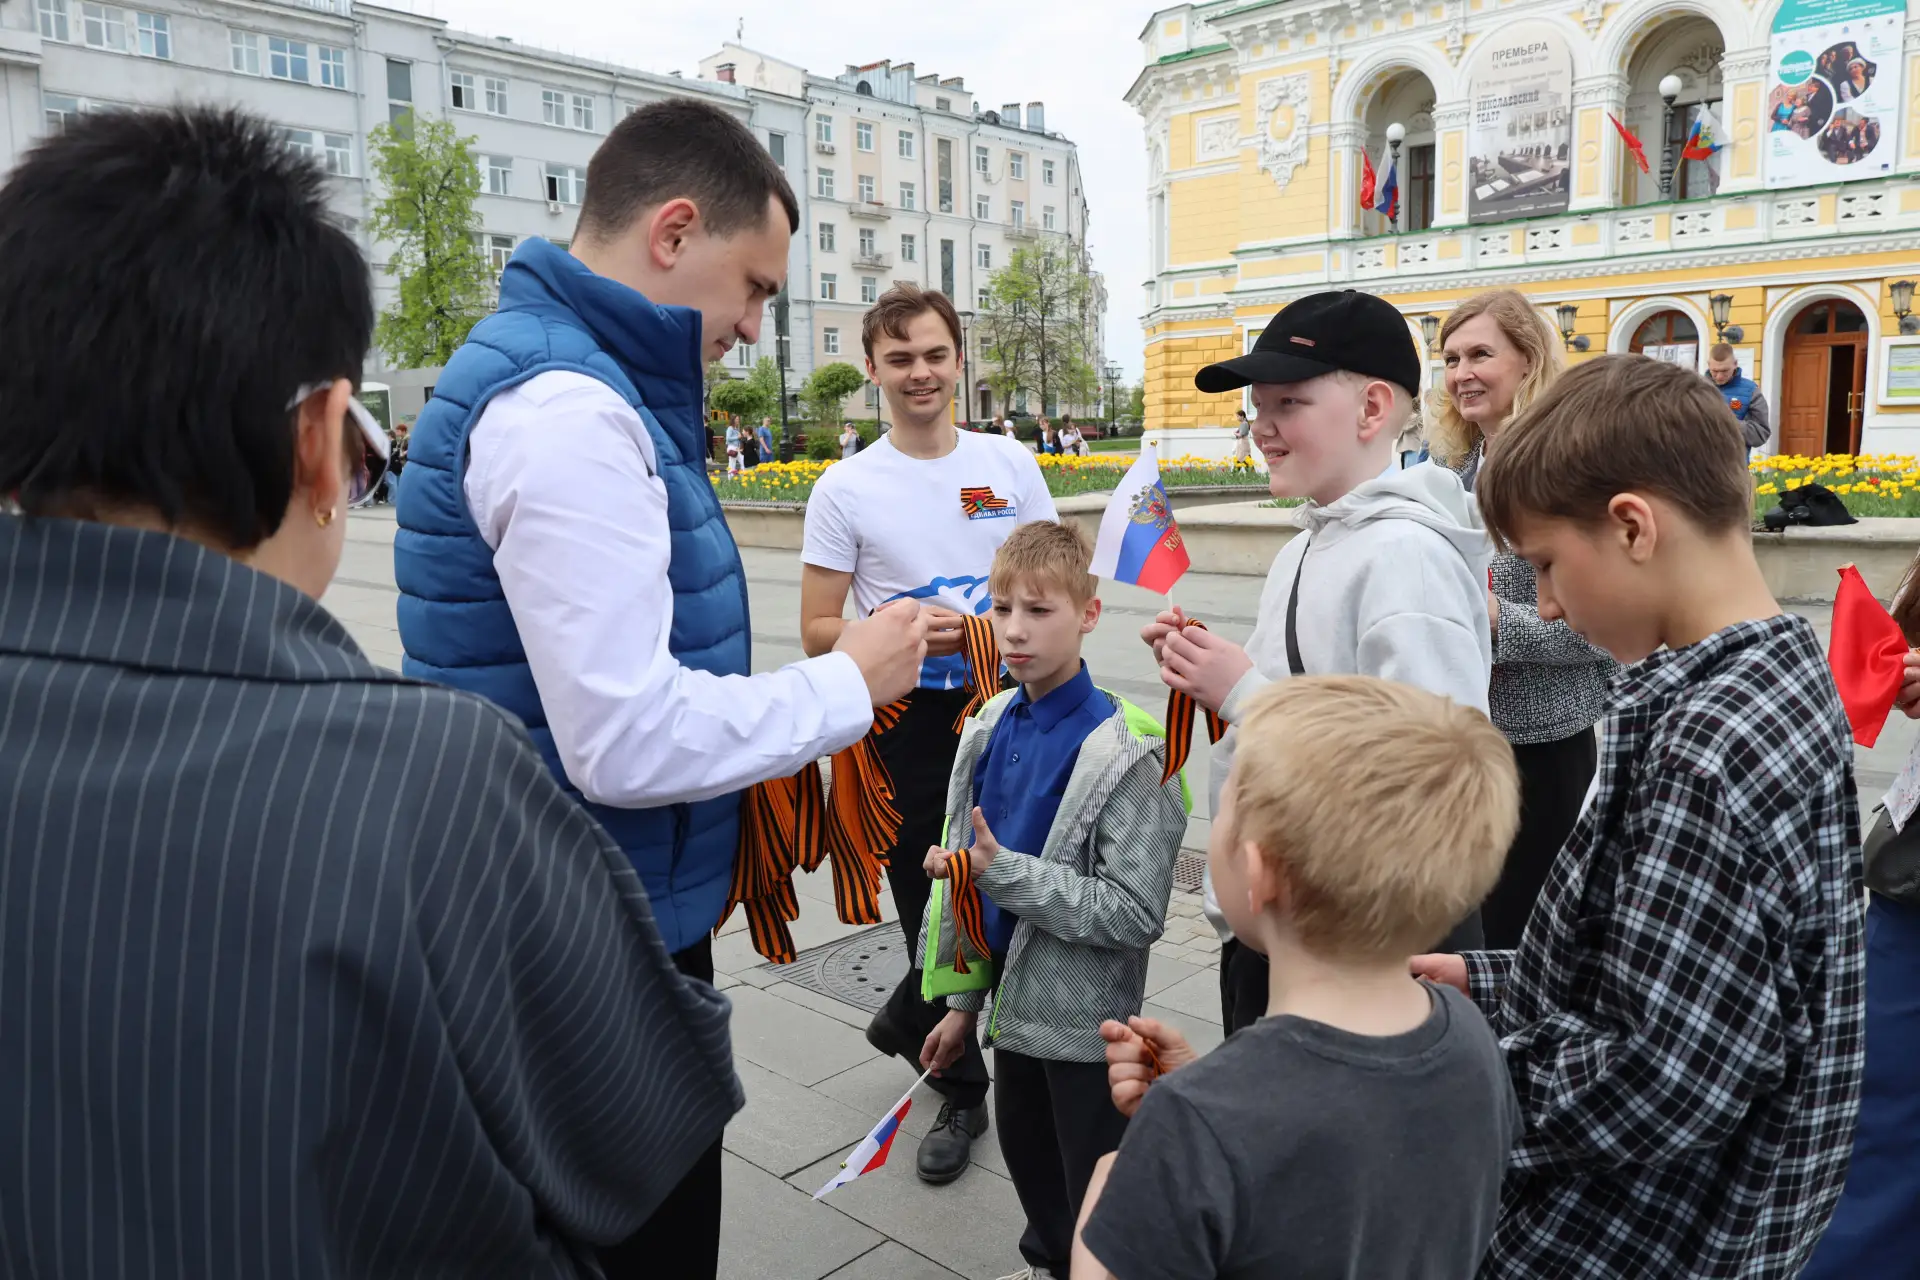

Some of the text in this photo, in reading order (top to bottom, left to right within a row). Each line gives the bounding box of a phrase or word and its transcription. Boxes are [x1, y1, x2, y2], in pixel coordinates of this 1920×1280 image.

[1492, 42, 1548, 61] ПРЕМЬЕРА
[1476, 90, 1539, 112] НИКОЛАЕВСКИЙ
[1476, 110, 1500, 123] ТЕАТР
